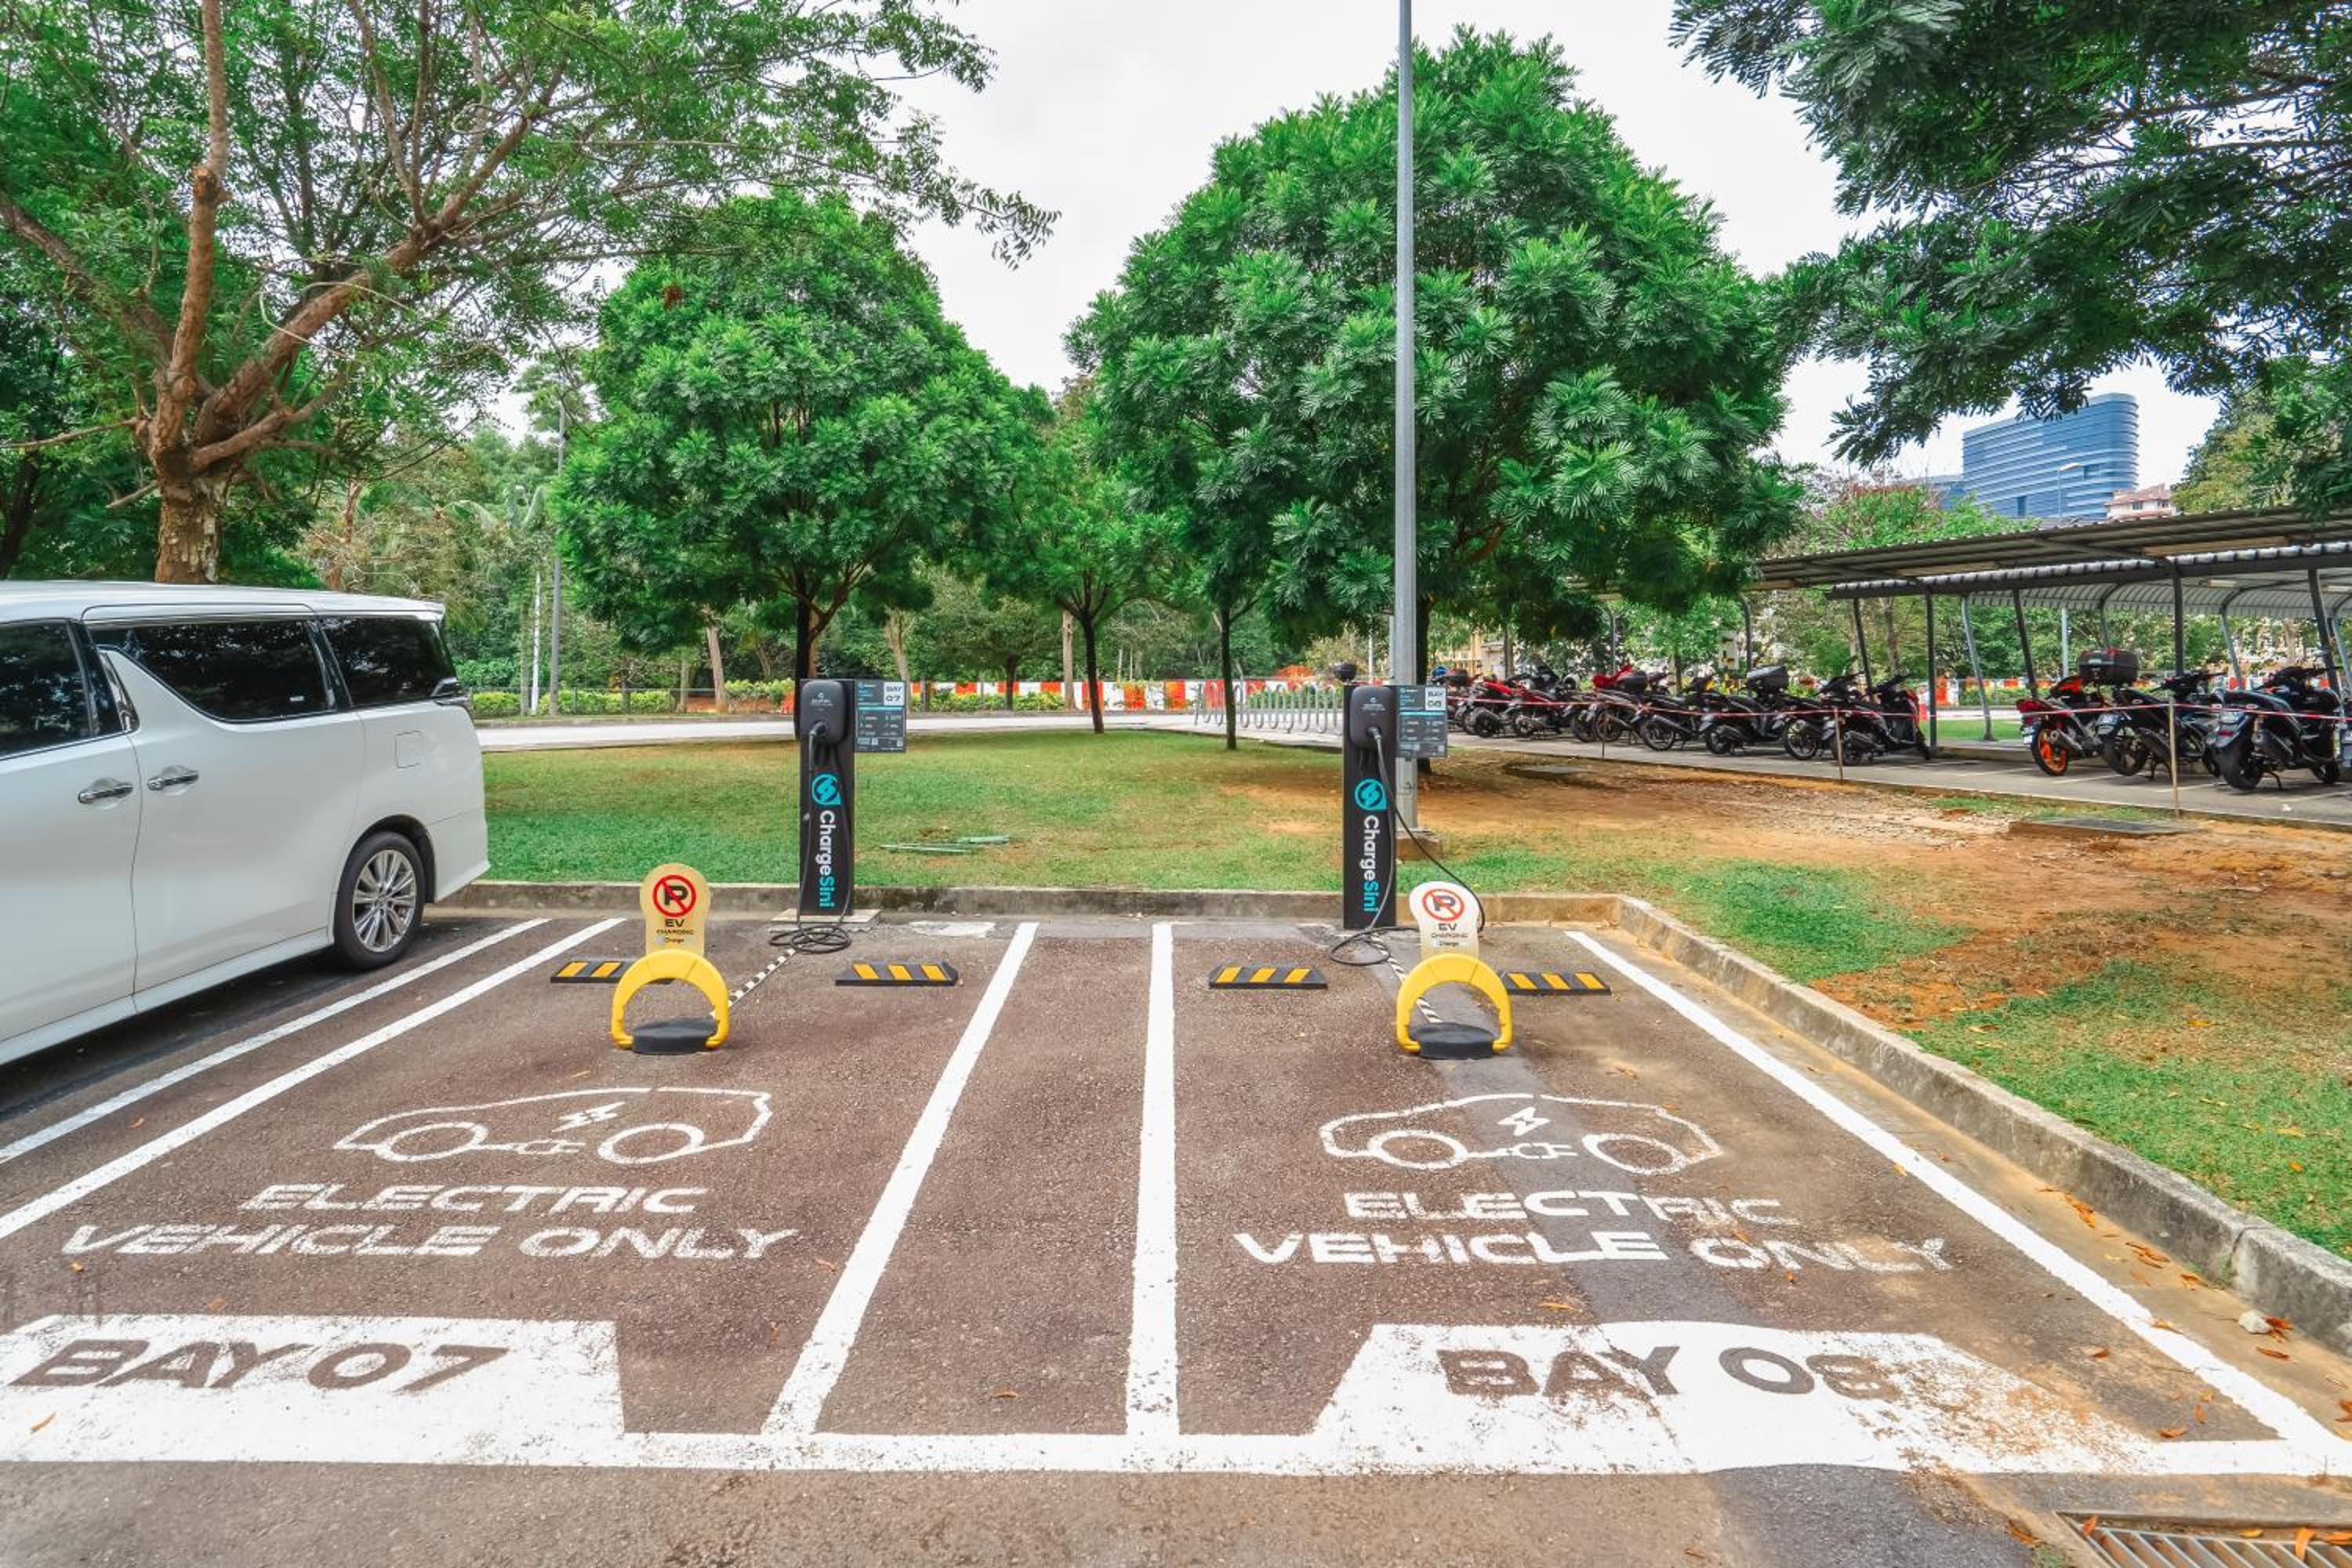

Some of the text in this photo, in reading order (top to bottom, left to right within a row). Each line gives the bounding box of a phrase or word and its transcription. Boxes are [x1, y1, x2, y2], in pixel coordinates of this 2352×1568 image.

[815, 810, 836, 907] ChargeSini
[1359, 815, 1380, 912] ChargeSini
[665, 918, 685, 927] EV
[238, 1184, 707, 1214] ELECTRIC
[1344, 1191, 1802, 1225] ELECTRIC
[62, 1224, 800, 1259] VEHICLE ONLY
[1233, 1231, 1954, 1271] VEHICLE ONLY
[6, 1339, 510, 1397] BAY 07
[1436, 1345, 1904, 1401] BAY 08
